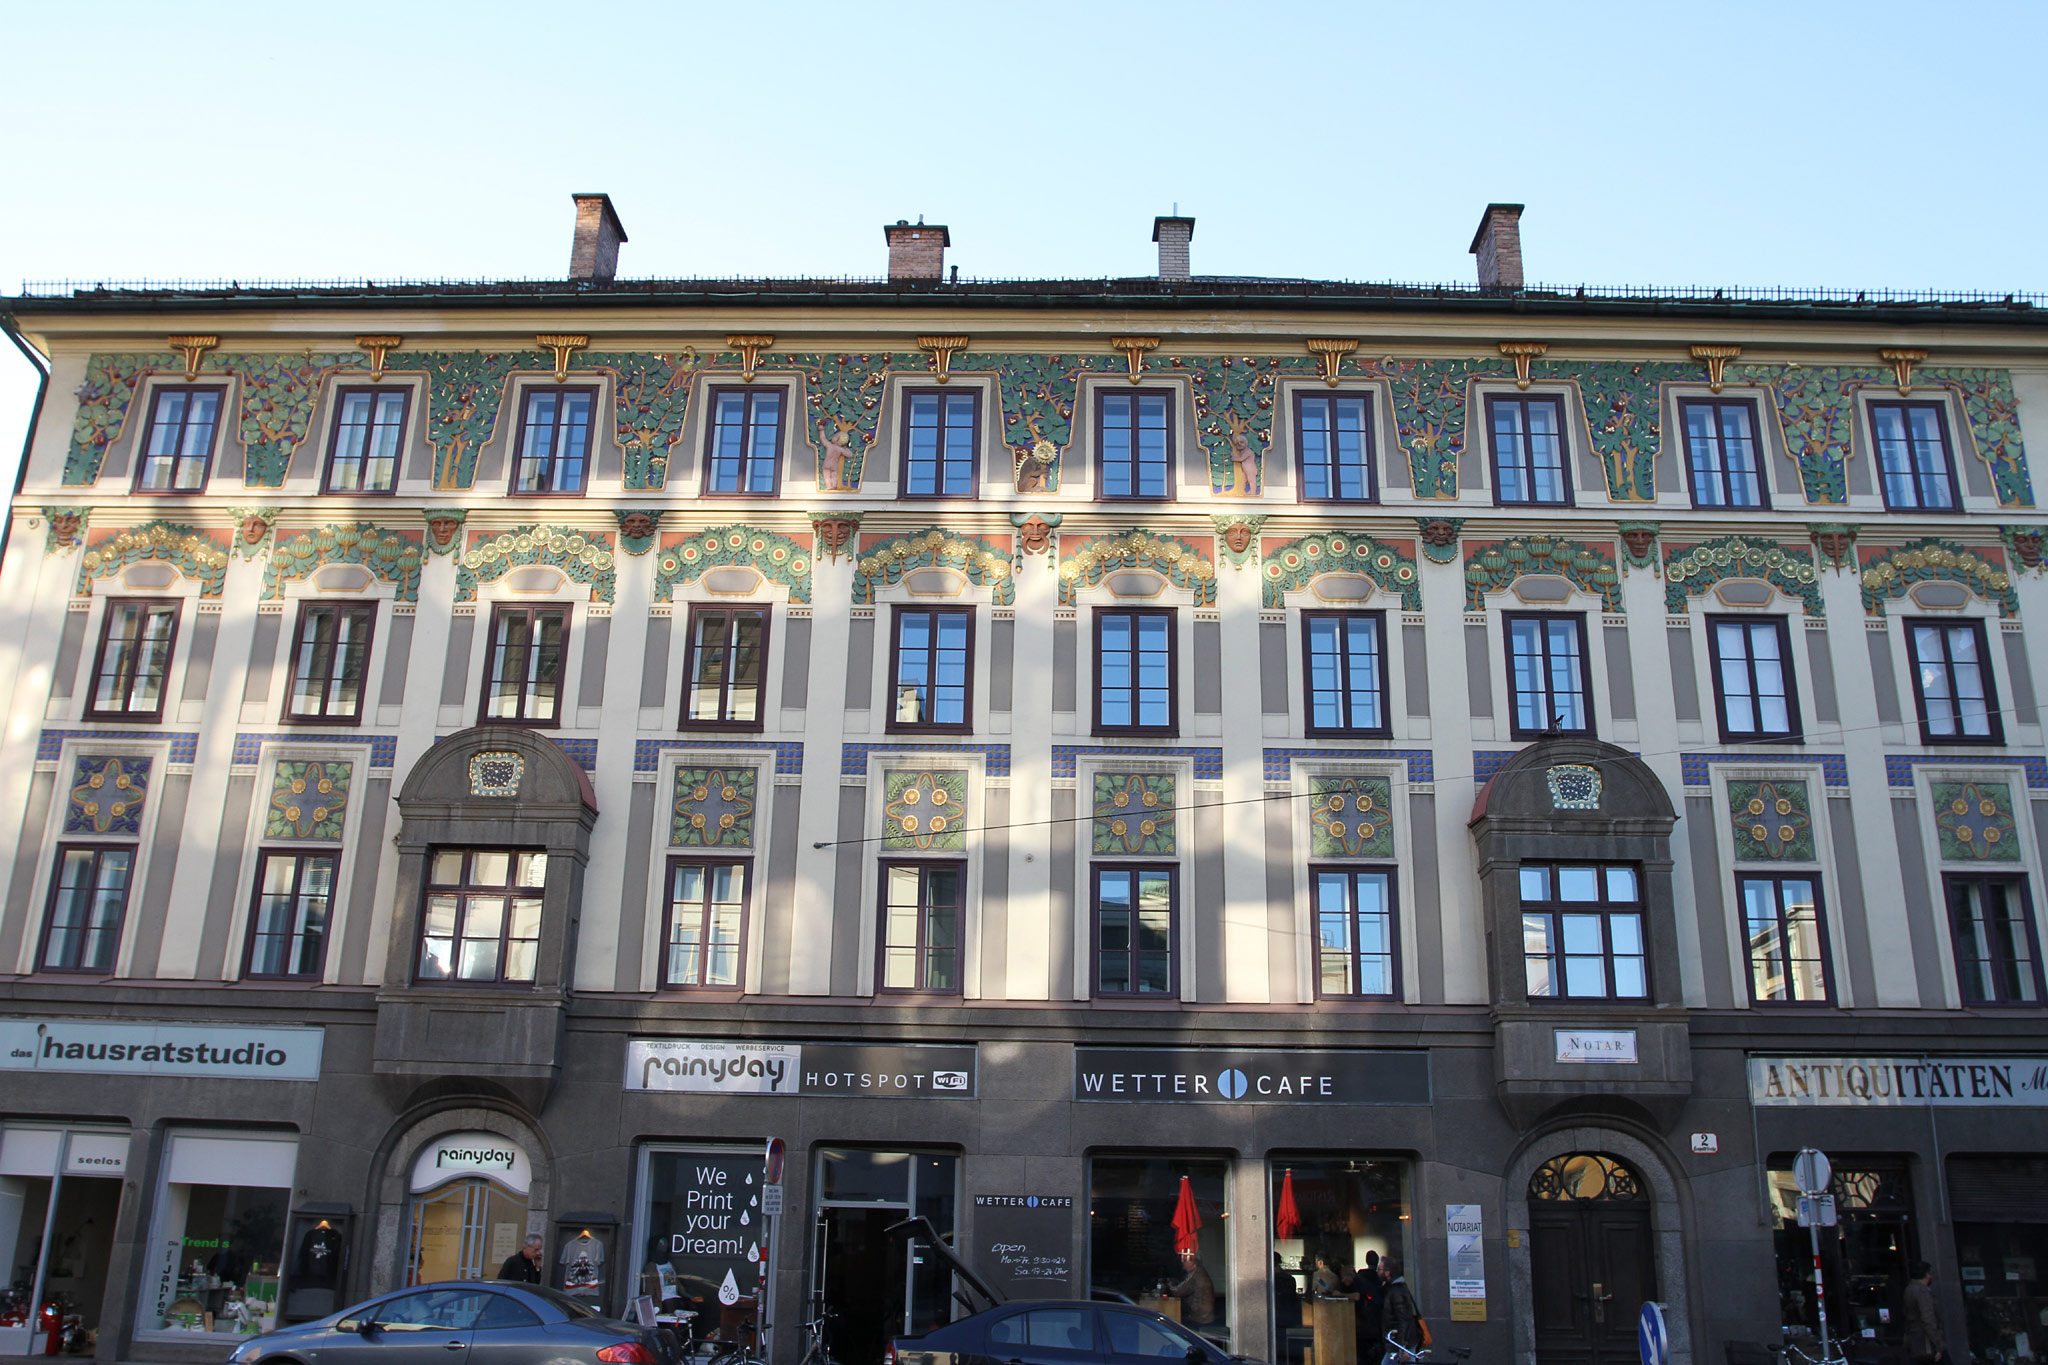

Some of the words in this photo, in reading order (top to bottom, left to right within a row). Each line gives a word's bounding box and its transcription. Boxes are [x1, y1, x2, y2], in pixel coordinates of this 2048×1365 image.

[11, 1048, 32, 1058] das
[43, 1036, 286, 1066] hausratstudio
[736, 1044, 785, 1052] WERBESERVICE
[643, 1055, 785, 1091] rainyday
[806, 1072, 925, 1088] HOTSPOT
[1765, 1063, 2014, 1100] ANTIQUITÄTEN
[1083, 1073, 1209, 1094] WETTER
[1256, 1076, 1332, 1095] CAFE
[1701, 1134, 1708, 1146] 2
[77, 1157, 121, 1166] seelos
[436, 1149, 515, 1170] rainyday
[696, 1167, 727, 1185] We
[687, 1190, 733, 1210] Print
[976, 1197, 1025, 1206] WETTER
[1041, 1198, 1071, 1207] CAFE
[686, 1214, 731, 1233] your
[1447, 1222, 1482, 1232] NOTARIAT
[671, 1234, 743, 1254] Dream!
[992, 1243, 1026, 1255] Open
